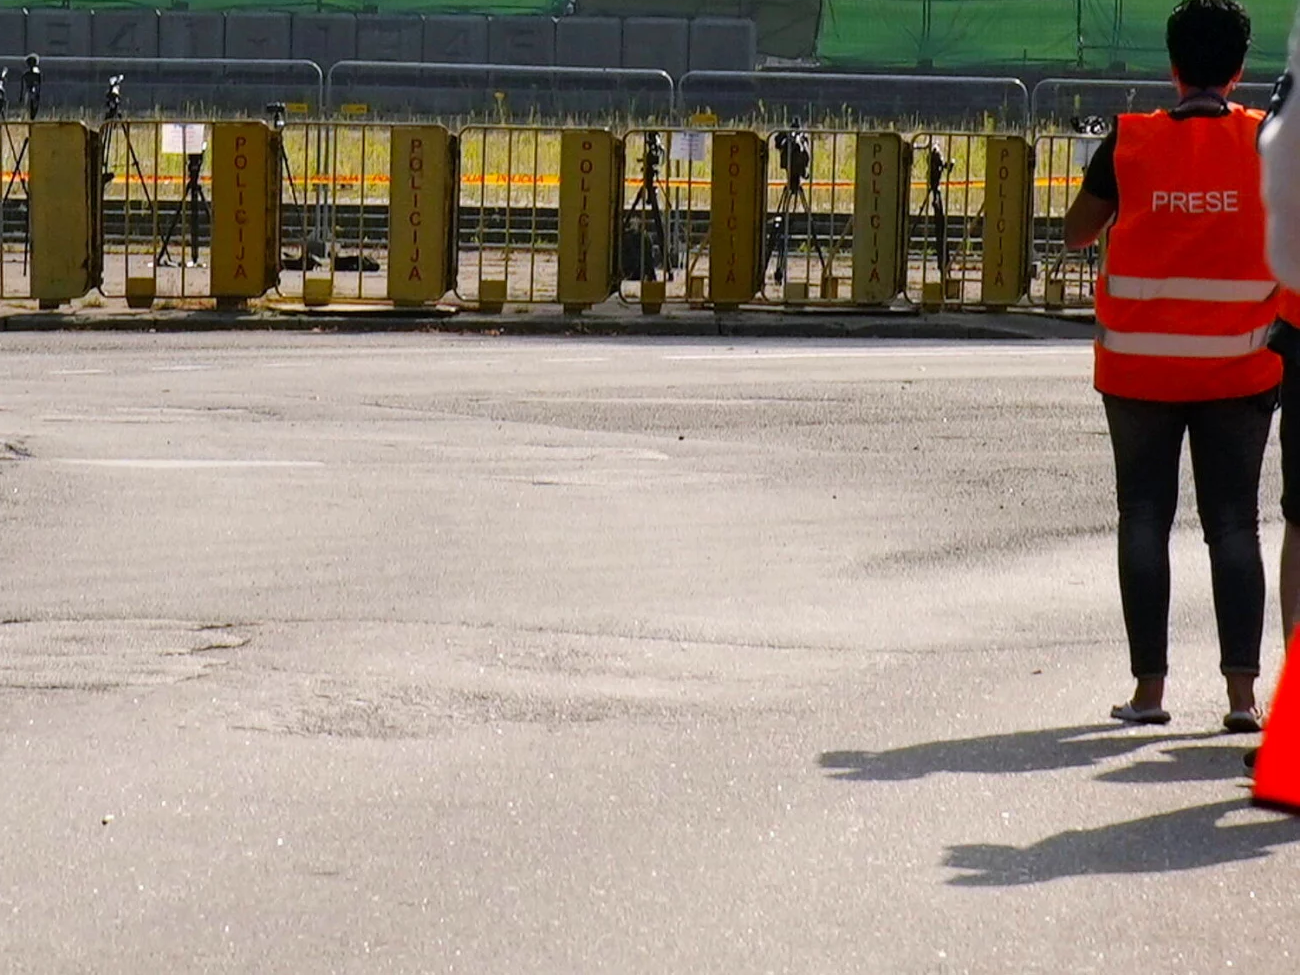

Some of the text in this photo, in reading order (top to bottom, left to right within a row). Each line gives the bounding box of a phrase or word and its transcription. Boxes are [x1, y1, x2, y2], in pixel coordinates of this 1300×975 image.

[233, 136, 248, 281] POLICIJA
[409, 137, 423, 283] POLICIJA
[726, 143, 740, 286] POLICIJA
[870, 143, 883, 284] POLICIJA
[994, 148, 1009, 288] POLICIJA
[1152, 191, 1239, 213] PRESE
